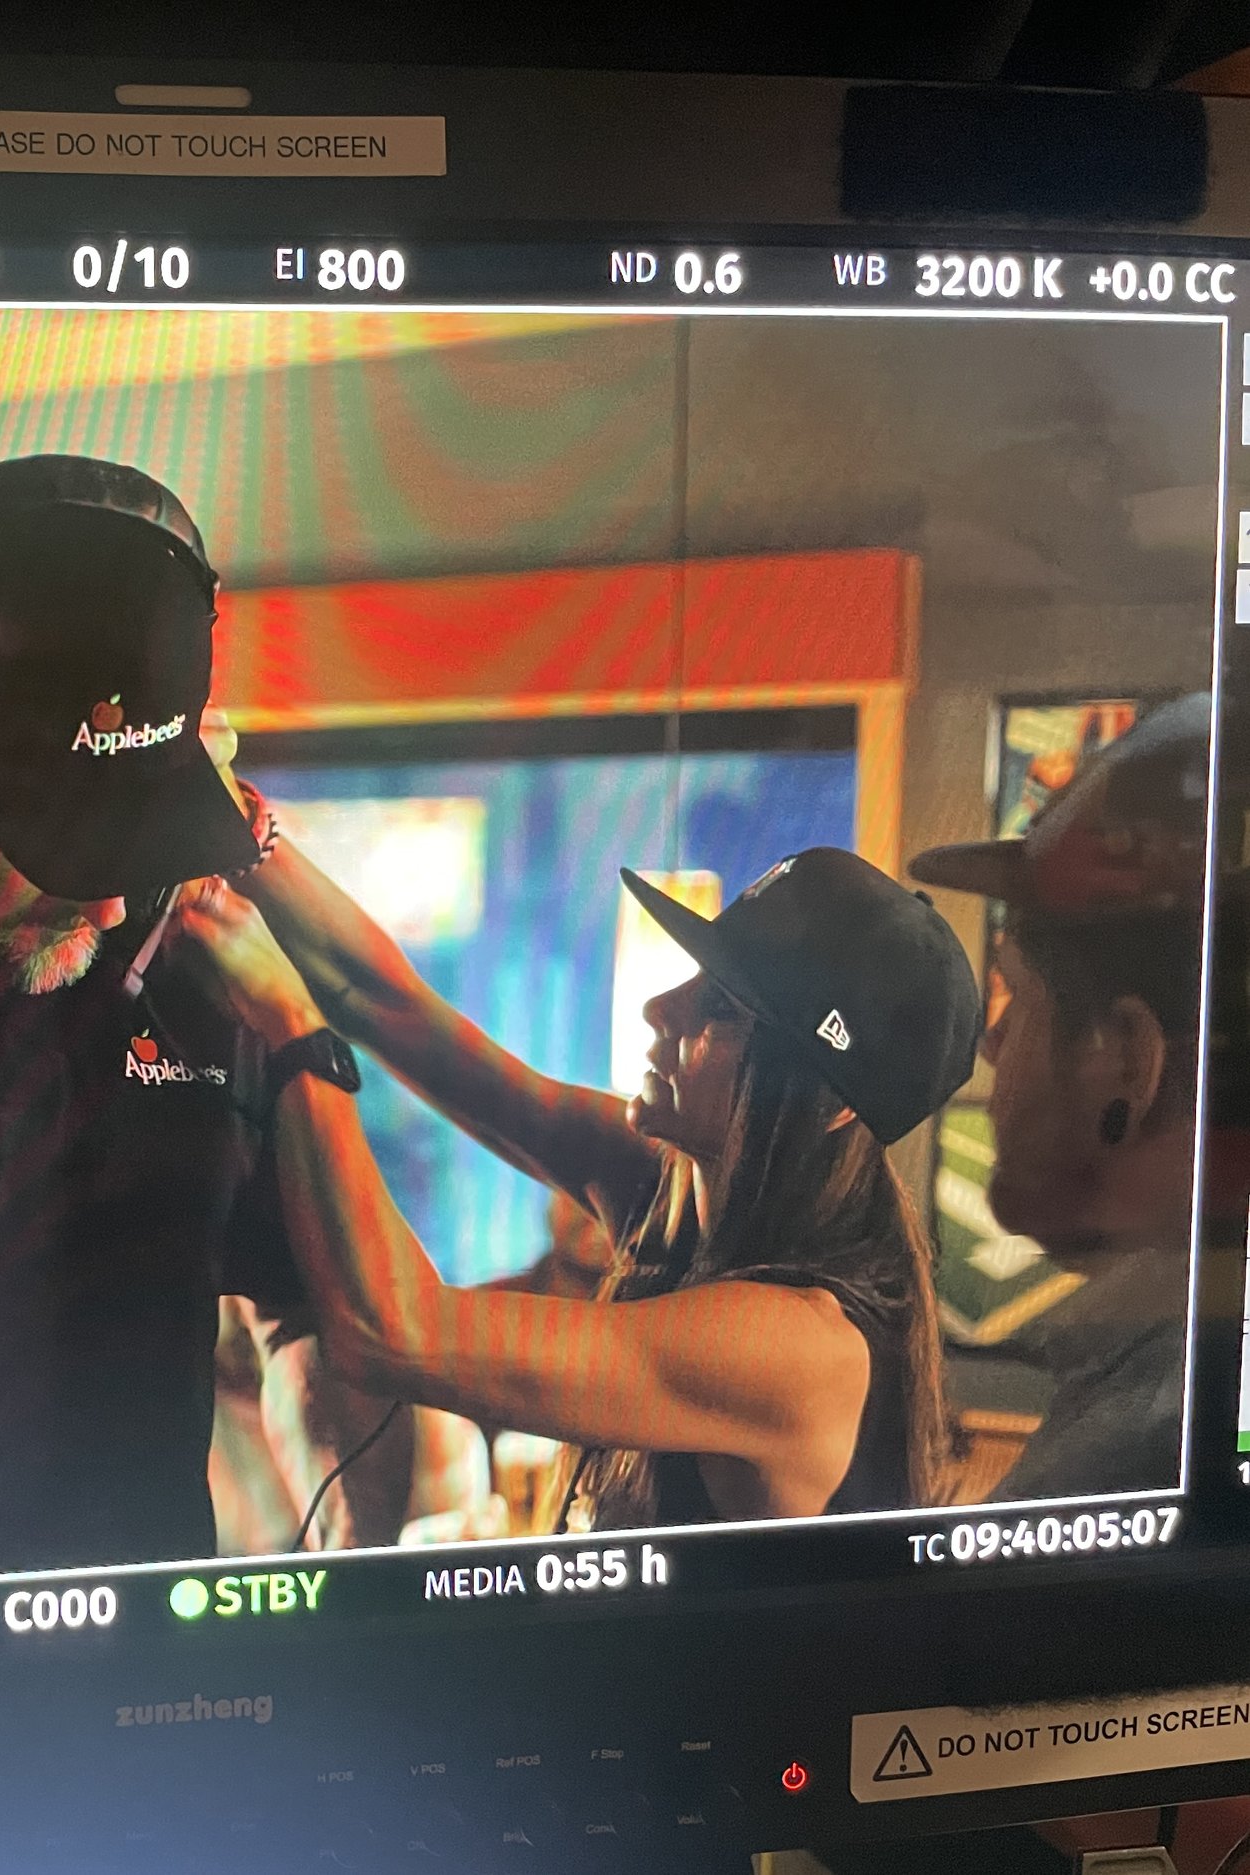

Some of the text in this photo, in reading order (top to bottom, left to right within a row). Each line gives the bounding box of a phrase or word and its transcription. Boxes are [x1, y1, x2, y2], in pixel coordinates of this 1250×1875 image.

[57, 133, 95, 155] DO
[107, 135, 160, 156] NOT
[173, 136, 265, 157] TOUCH
[278, 136, 385, 157] SCREEN
[73, 239, 189, 293] 0/10
[277, 248, 304, 279] EI
[317, 248, 405, 291] 800
[612, 251, 658, 282] ND
[674, 250, 744, 294] 0.6
[834, 253, 888, 285] WB
[915, 254, 1024, 299] 3200
[1033, 256, 1065, 299] K
[1089, 259, 1176, 302] +0.0
[1185, 261, 1238, 305] CC
[213, 1570, 327, 1616] STBY
[425, 1565, 525, 1600] MEDIA
[537, 1549, 628, 1593] 0:55
[642, 1544, 668, 1585] h
[908, 1534, 945, 1562] TC
[950, 1507, 1179, 1561] 09:40:05:07
[116, 1694, 272, 1726] zunzheng
[939, 1705, 1248, 1757] DO NOT TOUCH SCREEN
